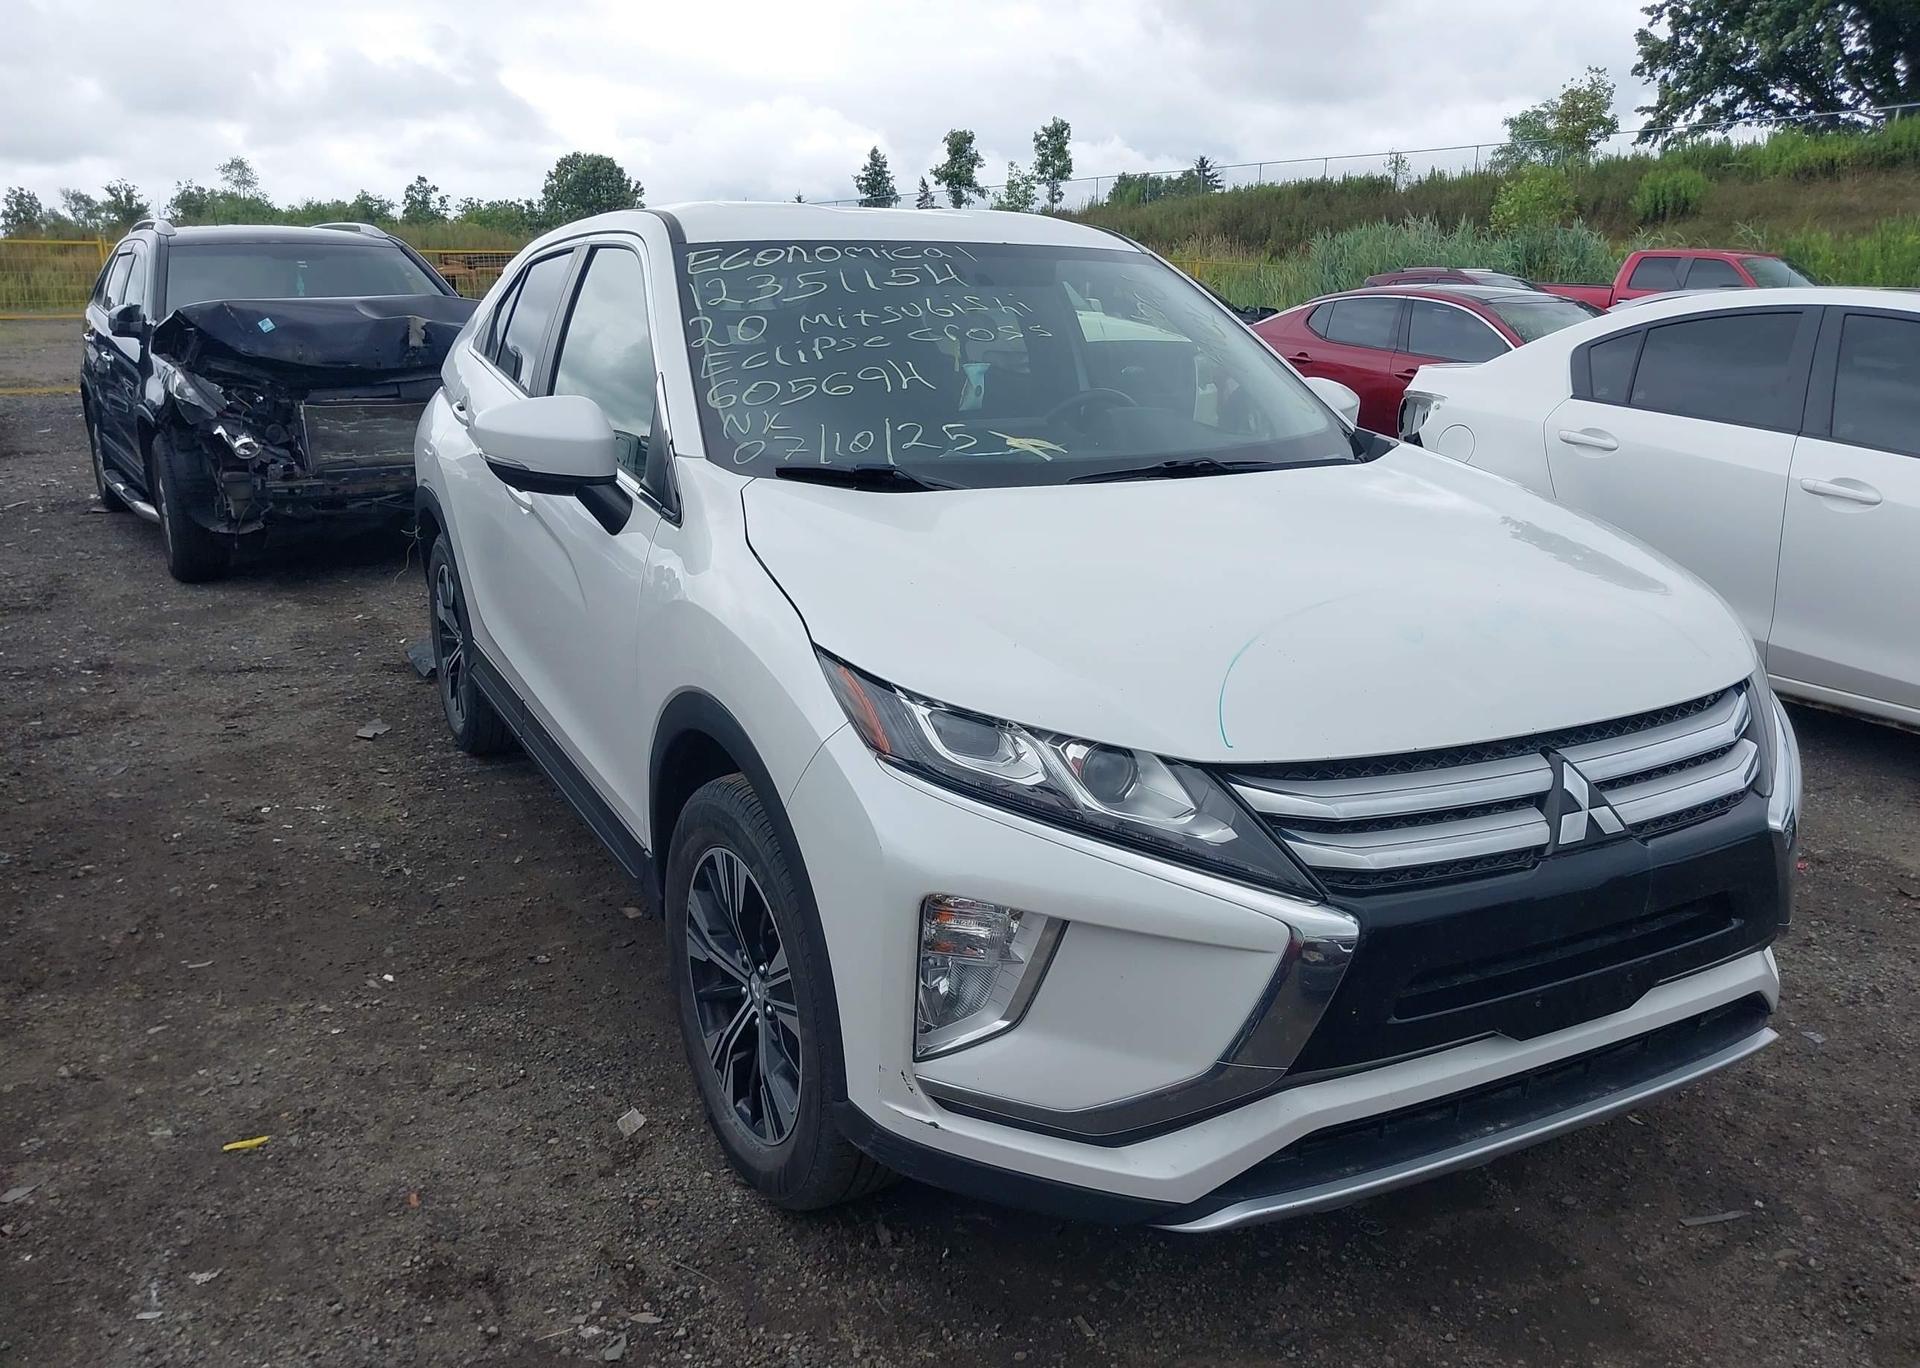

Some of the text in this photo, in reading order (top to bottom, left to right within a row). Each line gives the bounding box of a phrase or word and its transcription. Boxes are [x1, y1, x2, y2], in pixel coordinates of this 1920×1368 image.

[689, 263, 970, 311] 12351154
[688, 315, 768, 348] 20
[733, 417, 978, 469] 07/10/25
